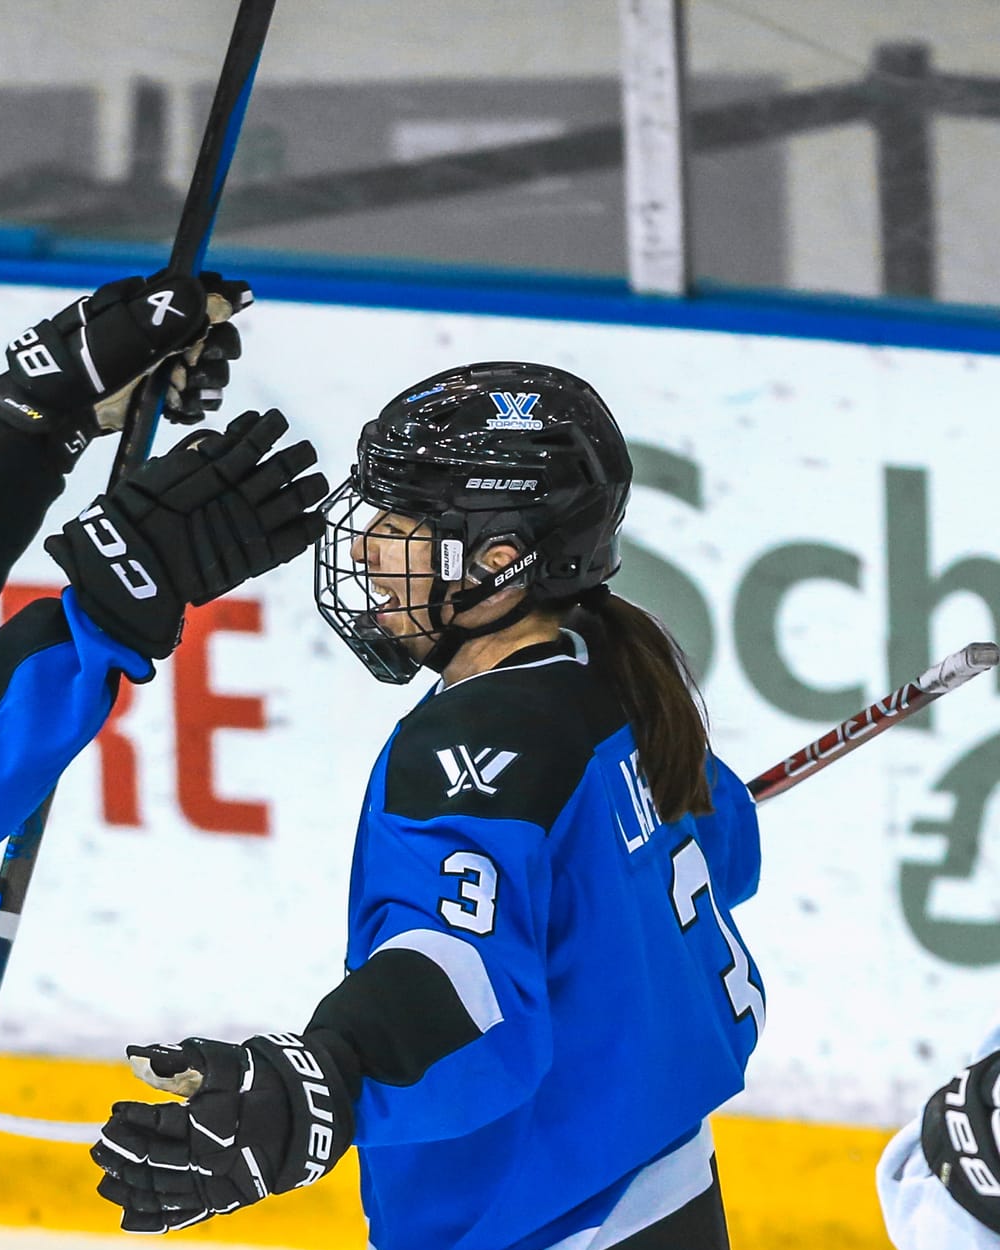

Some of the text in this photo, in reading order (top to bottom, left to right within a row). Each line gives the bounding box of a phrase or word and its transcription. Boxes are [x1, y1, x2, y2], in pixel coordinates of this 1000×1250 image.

[487, 419, 543, 431] TORONTO
[465, 477, 538, 491] BAUER
[438, 850, 499, 936] 3
